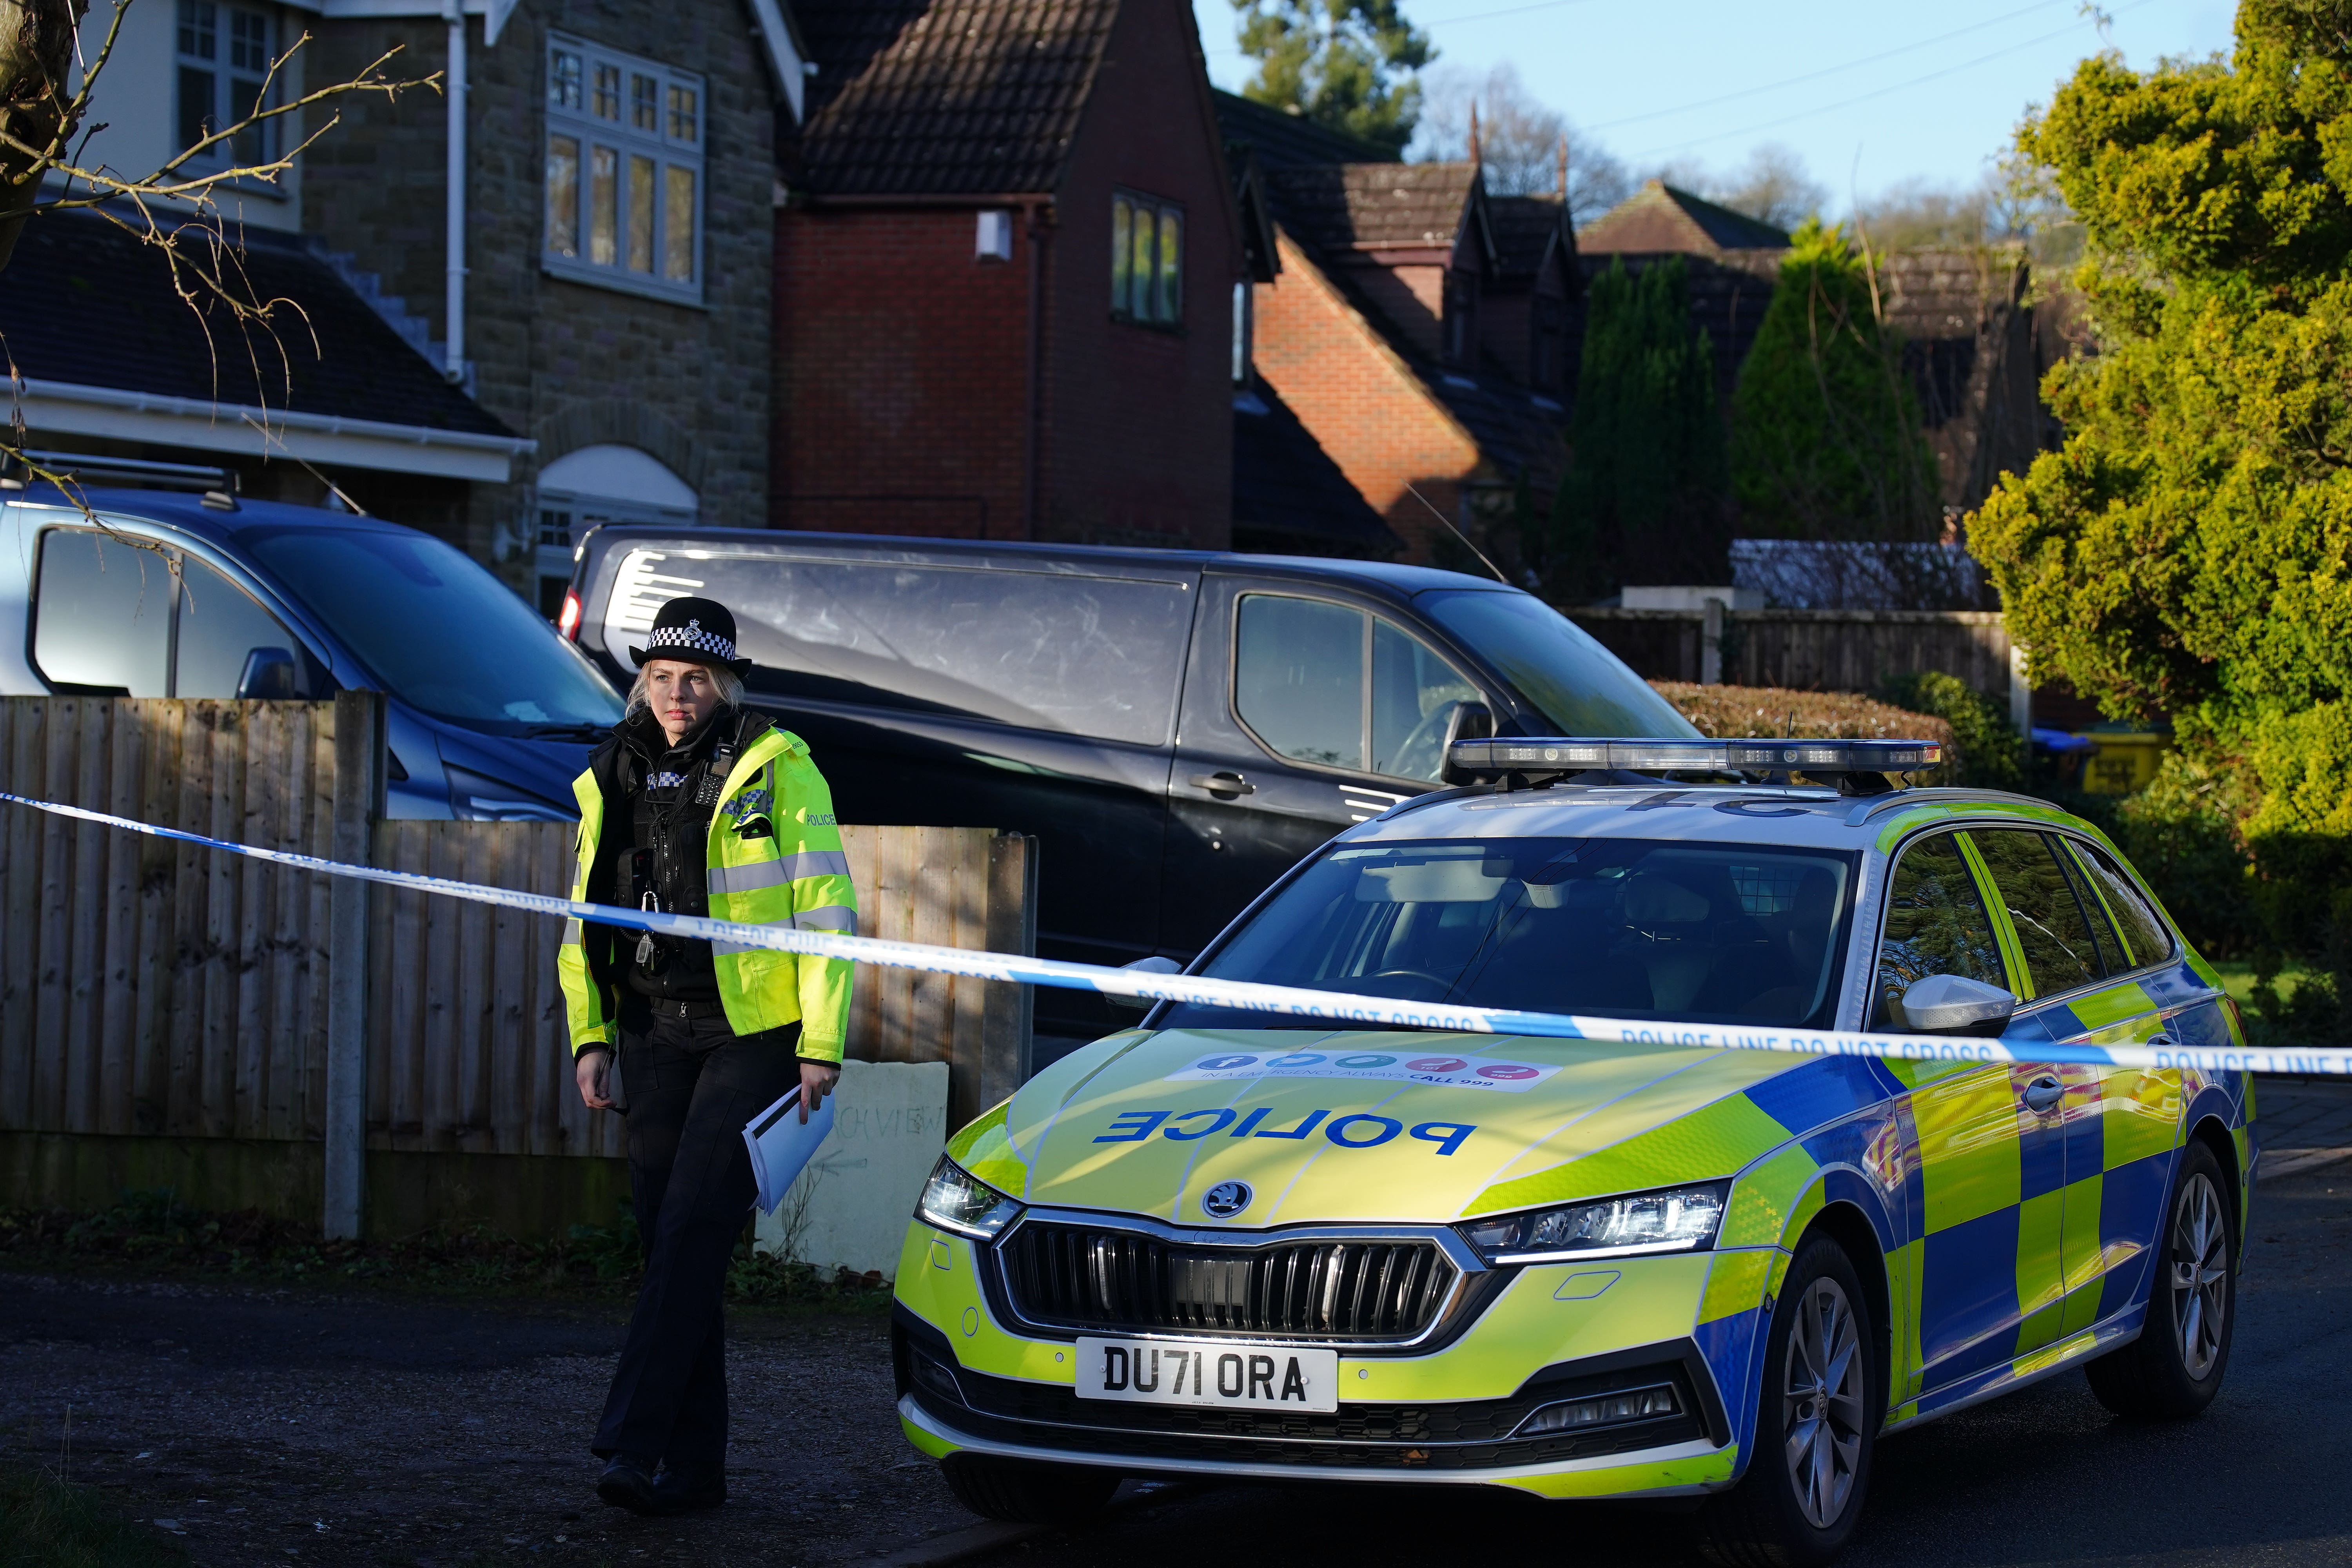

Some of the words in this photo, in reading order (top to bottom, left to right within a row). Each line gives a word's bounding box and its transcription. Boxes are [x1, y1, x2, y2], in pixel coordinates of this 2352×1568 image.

[807, 814, 836, 826] POLICE
[1409, 1074, 1454, 1083] CALL
[1104, 1346, 1202, 1396] DU71
[1218, 1353, 1307, 1401] ORA
